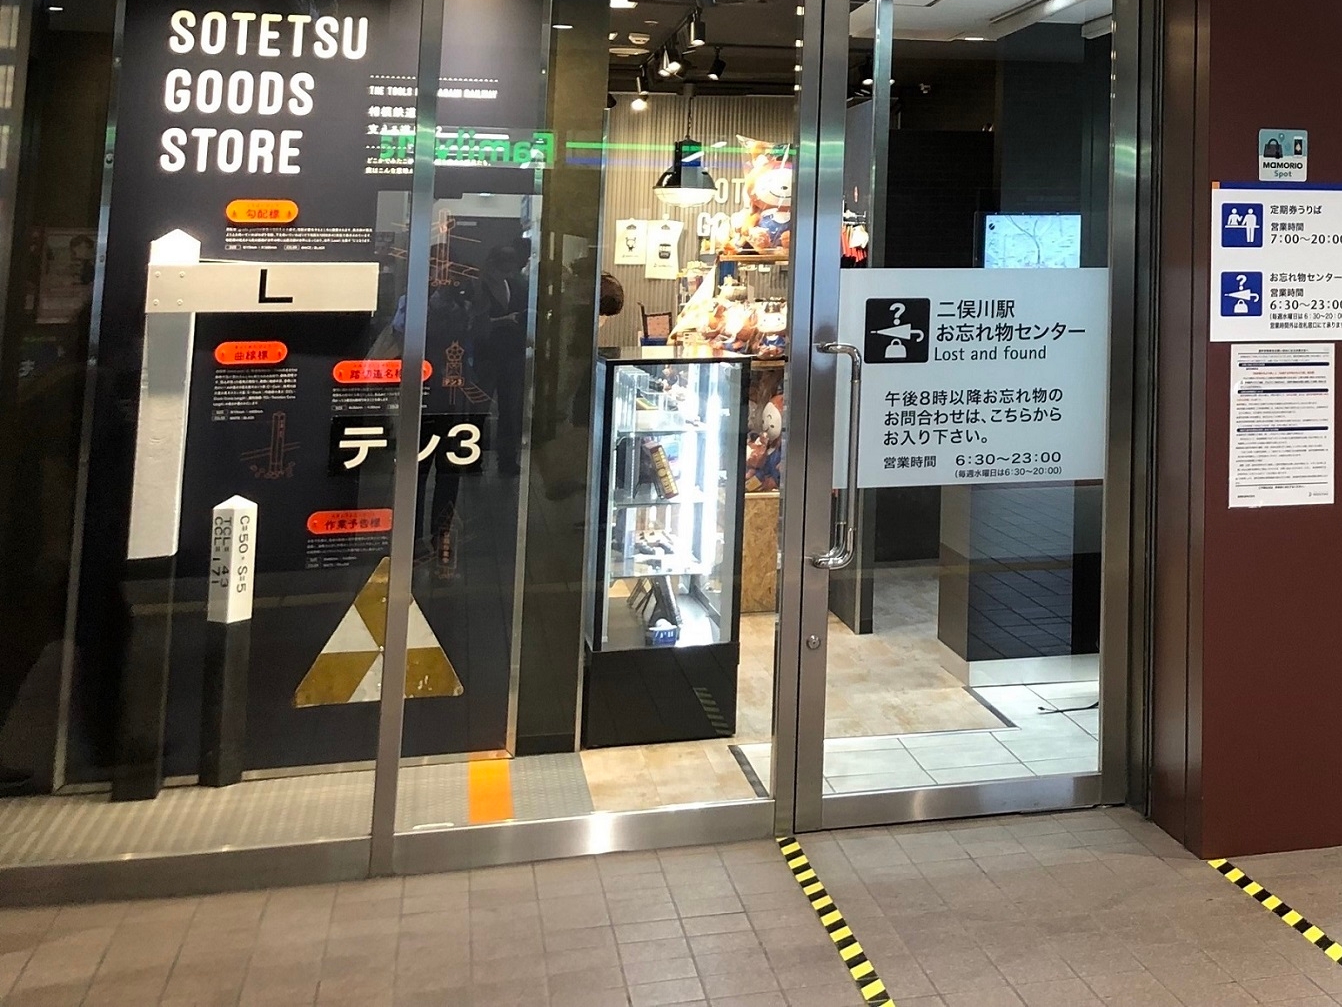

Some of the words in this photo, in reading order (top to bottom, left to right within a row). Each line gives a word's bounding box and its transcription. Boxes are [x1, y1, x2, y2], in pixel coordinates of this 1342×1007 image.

[169, 9, 369, 60] SOTETSU
[163, 68, 315, 116] GOODS
[160, 126, 303, 174] STORE
[1274, 170, 1293, 179] Spot
[1270, 204, 1322, 215] 定期券うりば
[1270, 222, 1304, 232] 営業時間
[258, 268, 294, 304] L
[1269, 272, 1342, 283] お忘れ物センター
[1270, 288, 1304, 298] 営業時間
[937, 299, 1015, 319] 二俣川駅
[936, 322, 1086, 342] お忘れ物センター
[934, 346, 965, 361] Lost
[970, 346, 998, 361] and
[1003, 345, 1046, 360] found
[885, 387, 1063, 407] 午後8時以降お忘れ物の
[884, 407, 1062, 427] お問合わせは、こちらから
[883, 429, 988, 446] お入り下さい。
[883, 455, 937, 468] 営業時間
